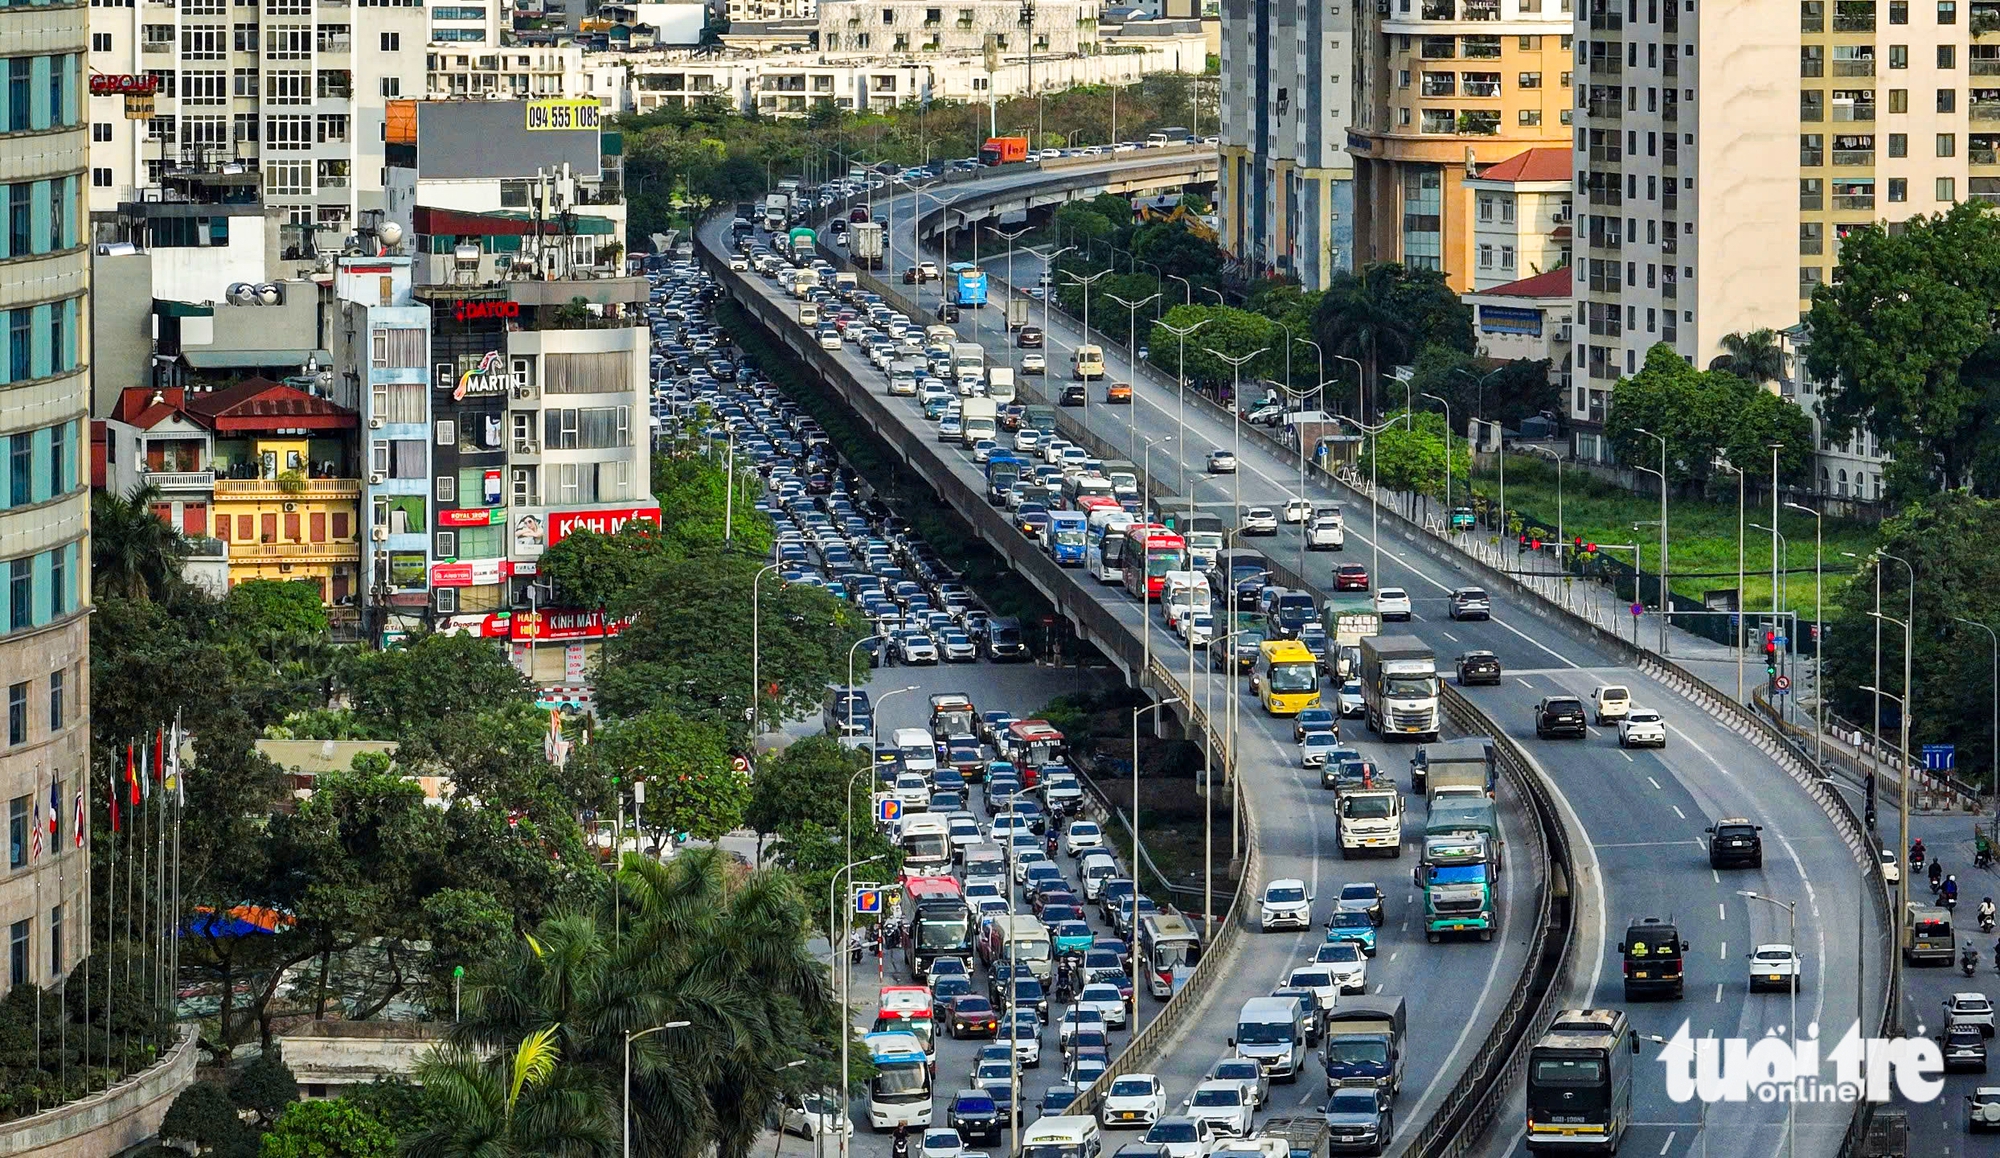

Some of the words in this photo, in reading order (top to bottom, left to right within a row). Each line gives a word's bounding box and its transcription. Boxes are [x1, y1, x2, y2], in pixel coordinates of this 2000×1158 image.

[91, 75, 158, 91] GROUP
[529, 106, 548, 127] 094
[551, 106, 571, 127] 555
[574, 106, 599, 127] 1085
[467, 373, 520, 394] MARTIN
[550, 613, 574, 629] KÍNH
